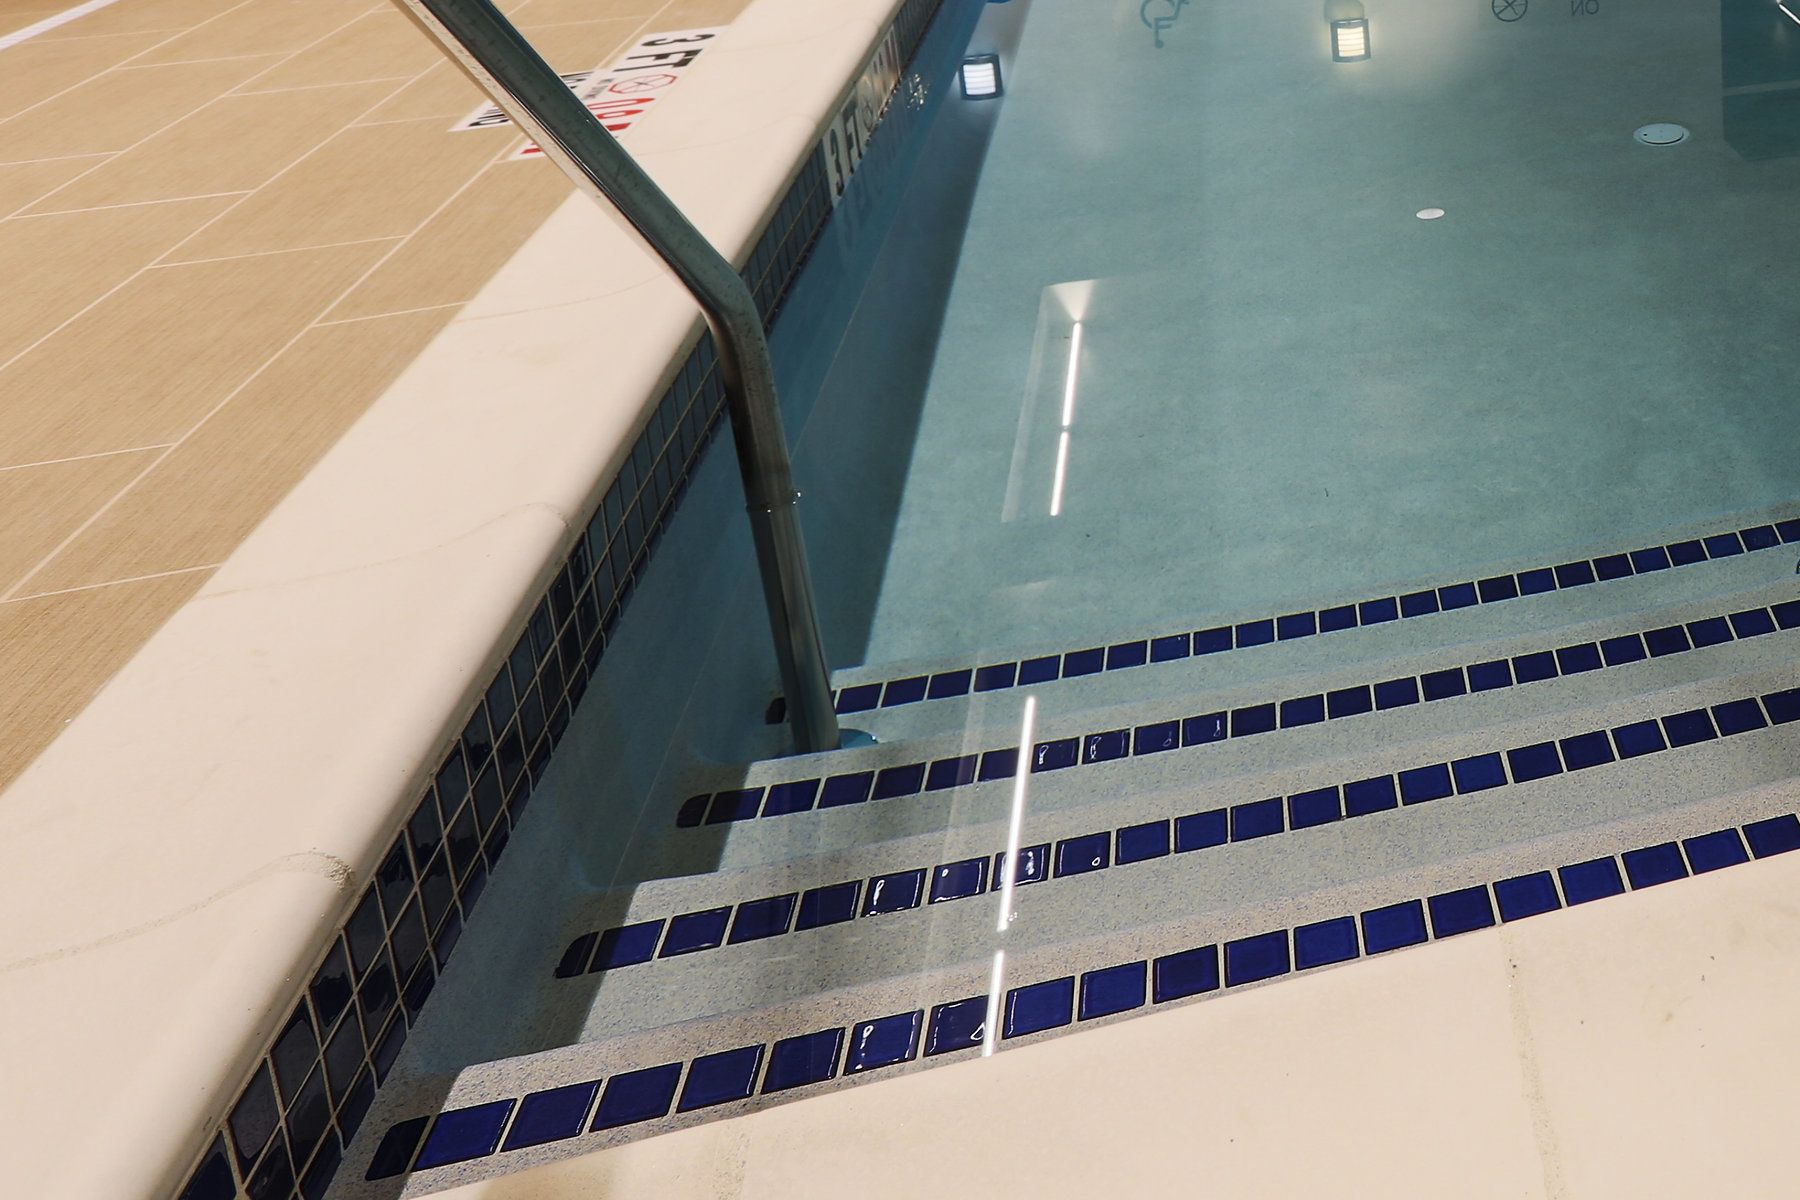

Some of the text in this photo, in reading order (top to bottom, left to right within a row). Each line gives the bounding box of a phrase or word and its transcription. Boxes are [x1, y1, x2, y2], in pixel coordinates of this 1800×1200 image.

[641, 33, 716, 47] 3
[612, 48, 704, 73] FT
[830, 95, 863, 197] 3 FT
